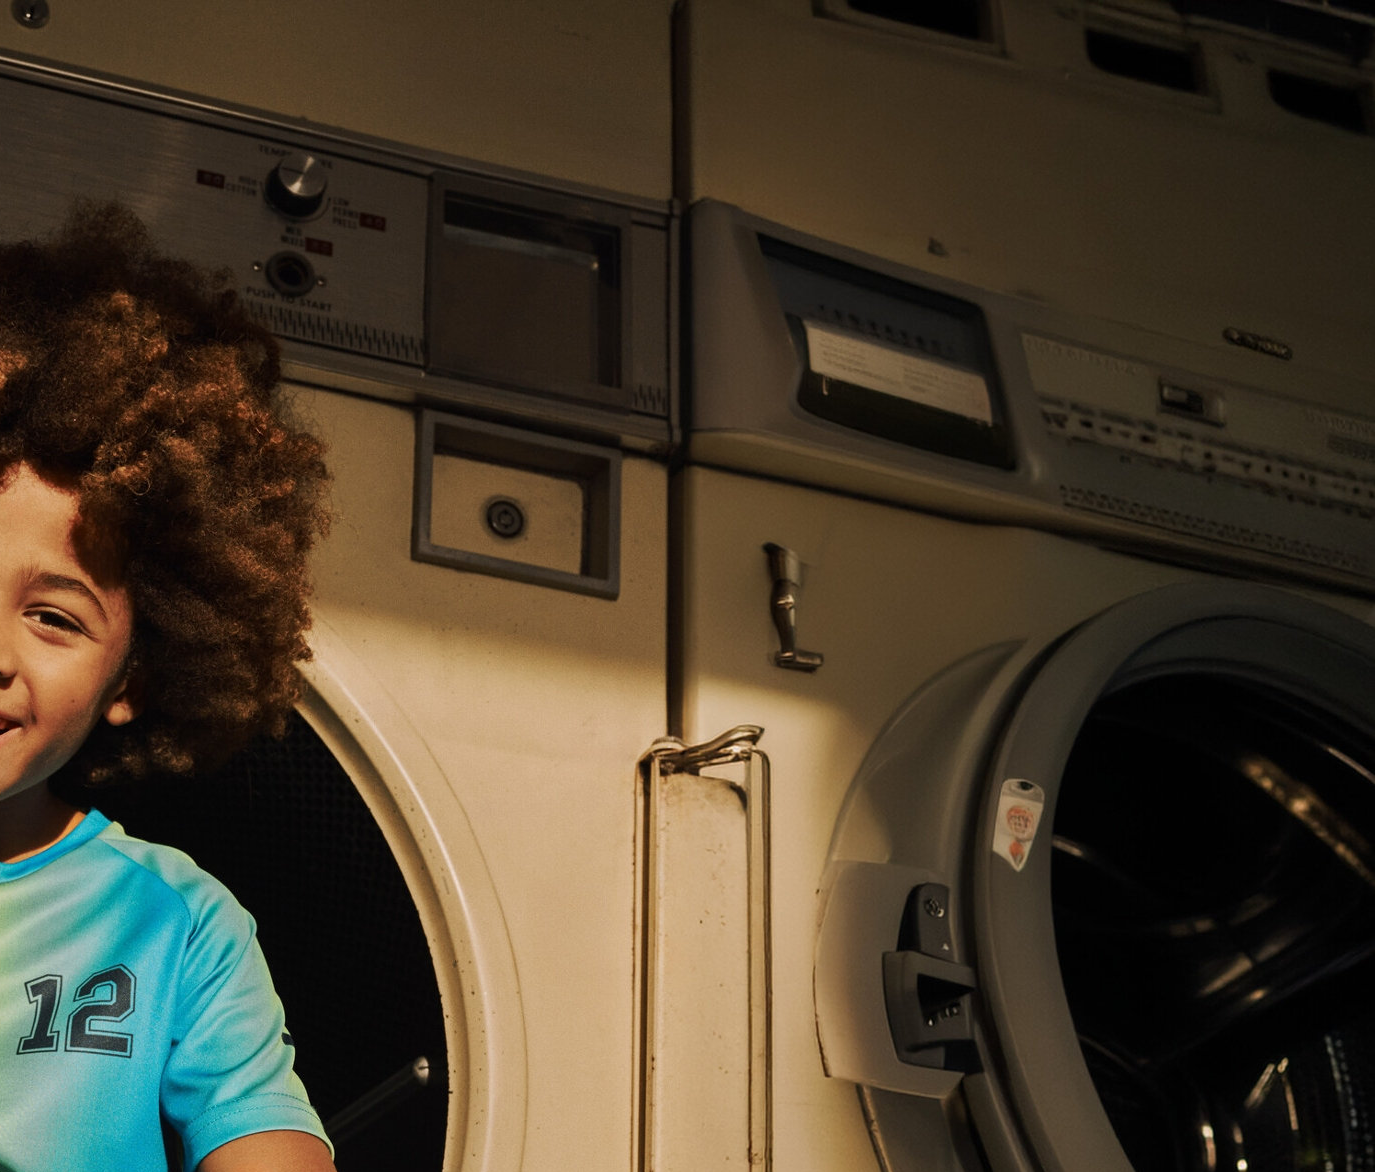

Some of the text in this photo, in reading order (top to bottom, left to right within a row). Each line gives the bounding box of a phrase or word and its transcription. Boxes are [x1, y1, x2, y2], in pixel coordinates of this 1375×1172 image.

[246, 286, 275, 300] PUSH
[300, 299, 332, 311] START
[16, 963, 137, 1059] 12
